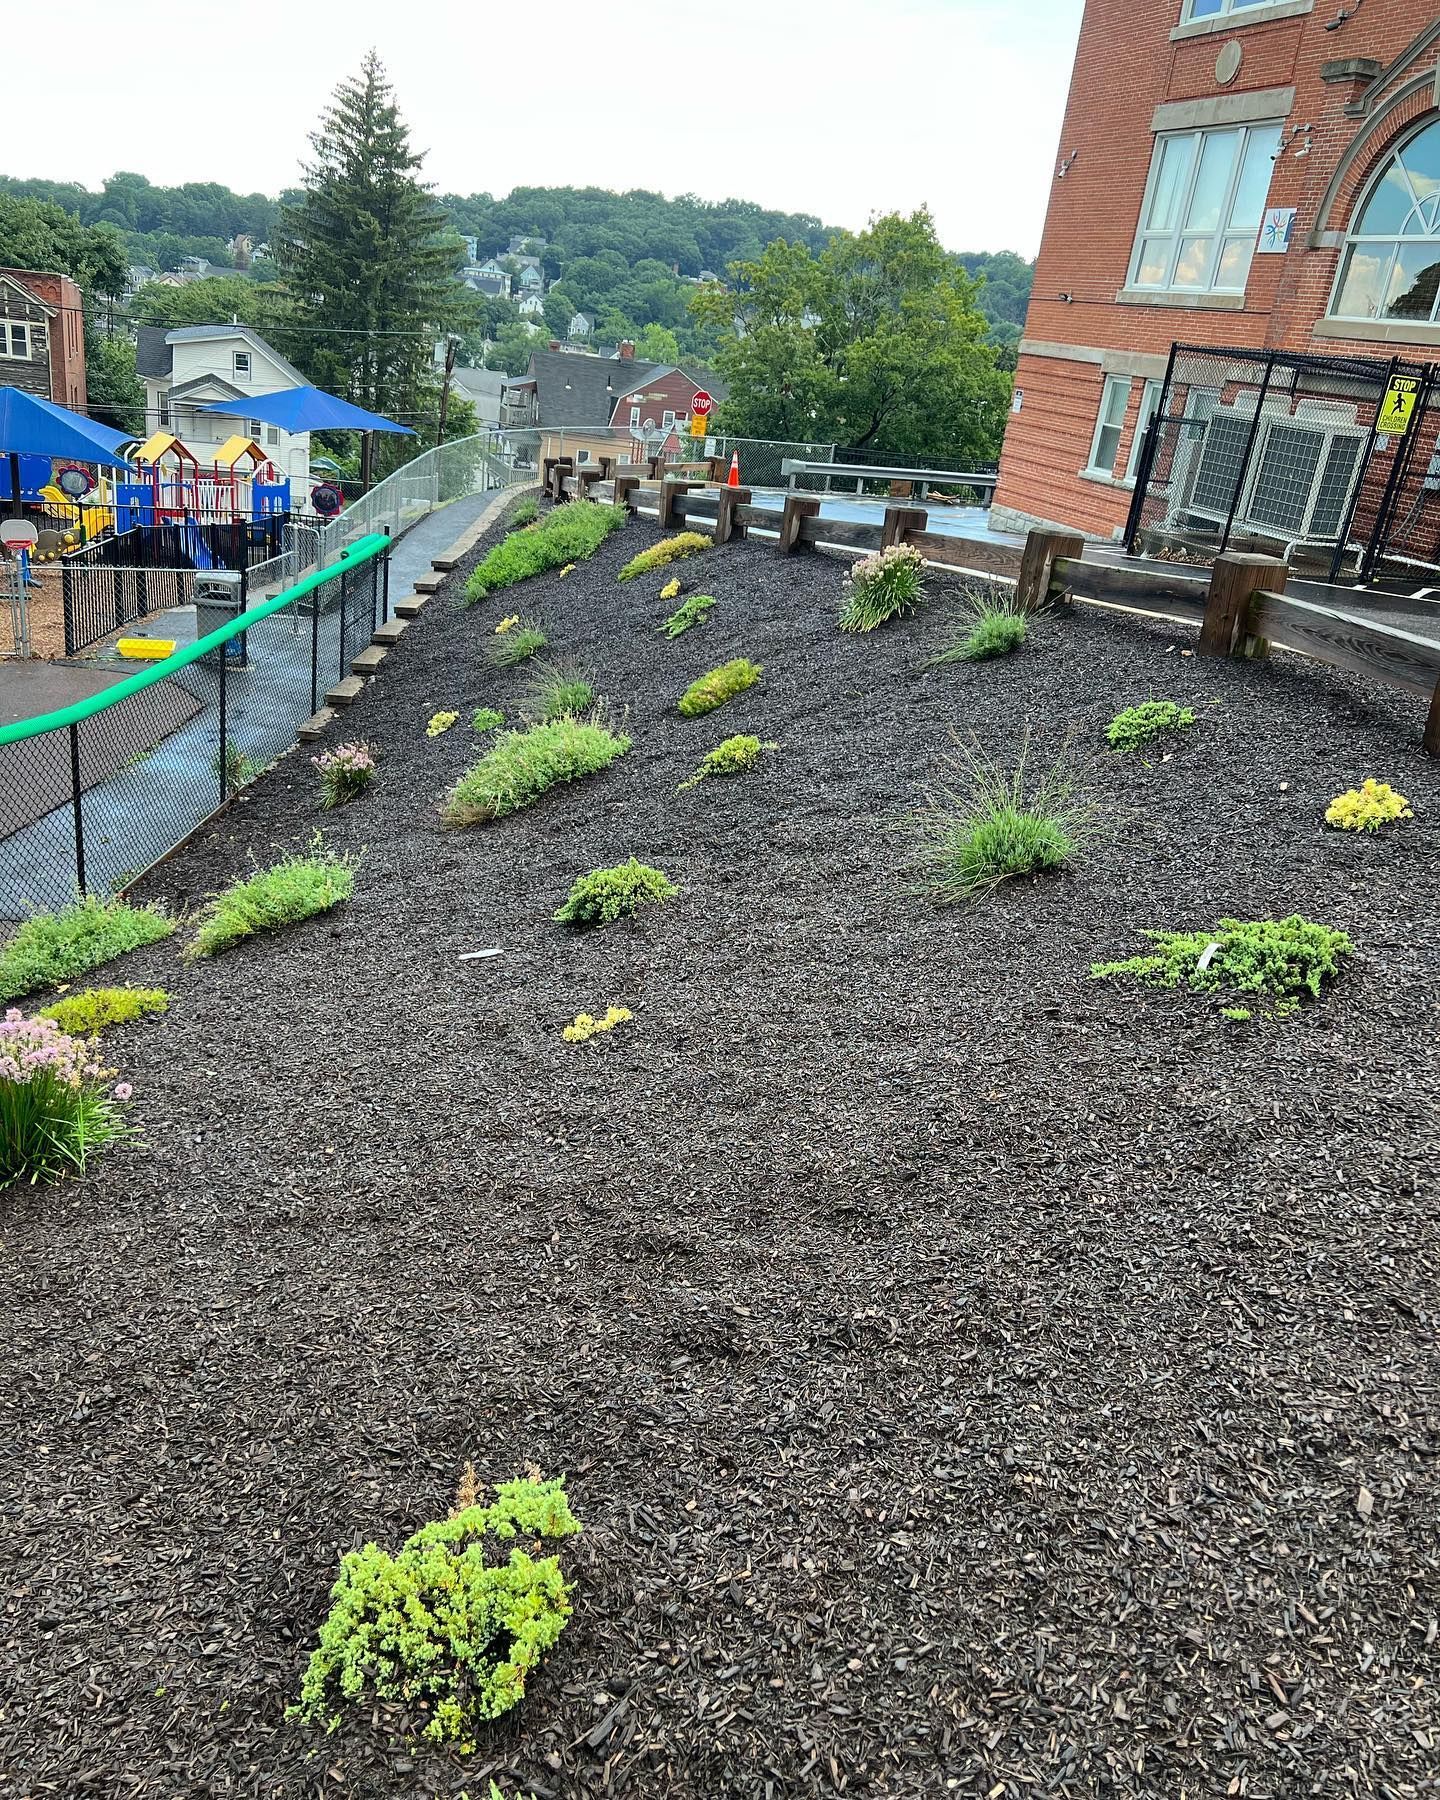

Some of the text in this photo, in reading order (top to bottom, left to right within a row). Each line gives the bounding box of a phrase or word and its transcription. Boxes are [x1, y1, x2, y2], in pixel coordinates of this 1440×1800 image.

[1393, 379, 1416, 391] STOP
[694, 398, 710, 408] STOP
[1382, 415, 1406, 423] CHILDREN
[1380, 421, 1406, 430] CROSSING
